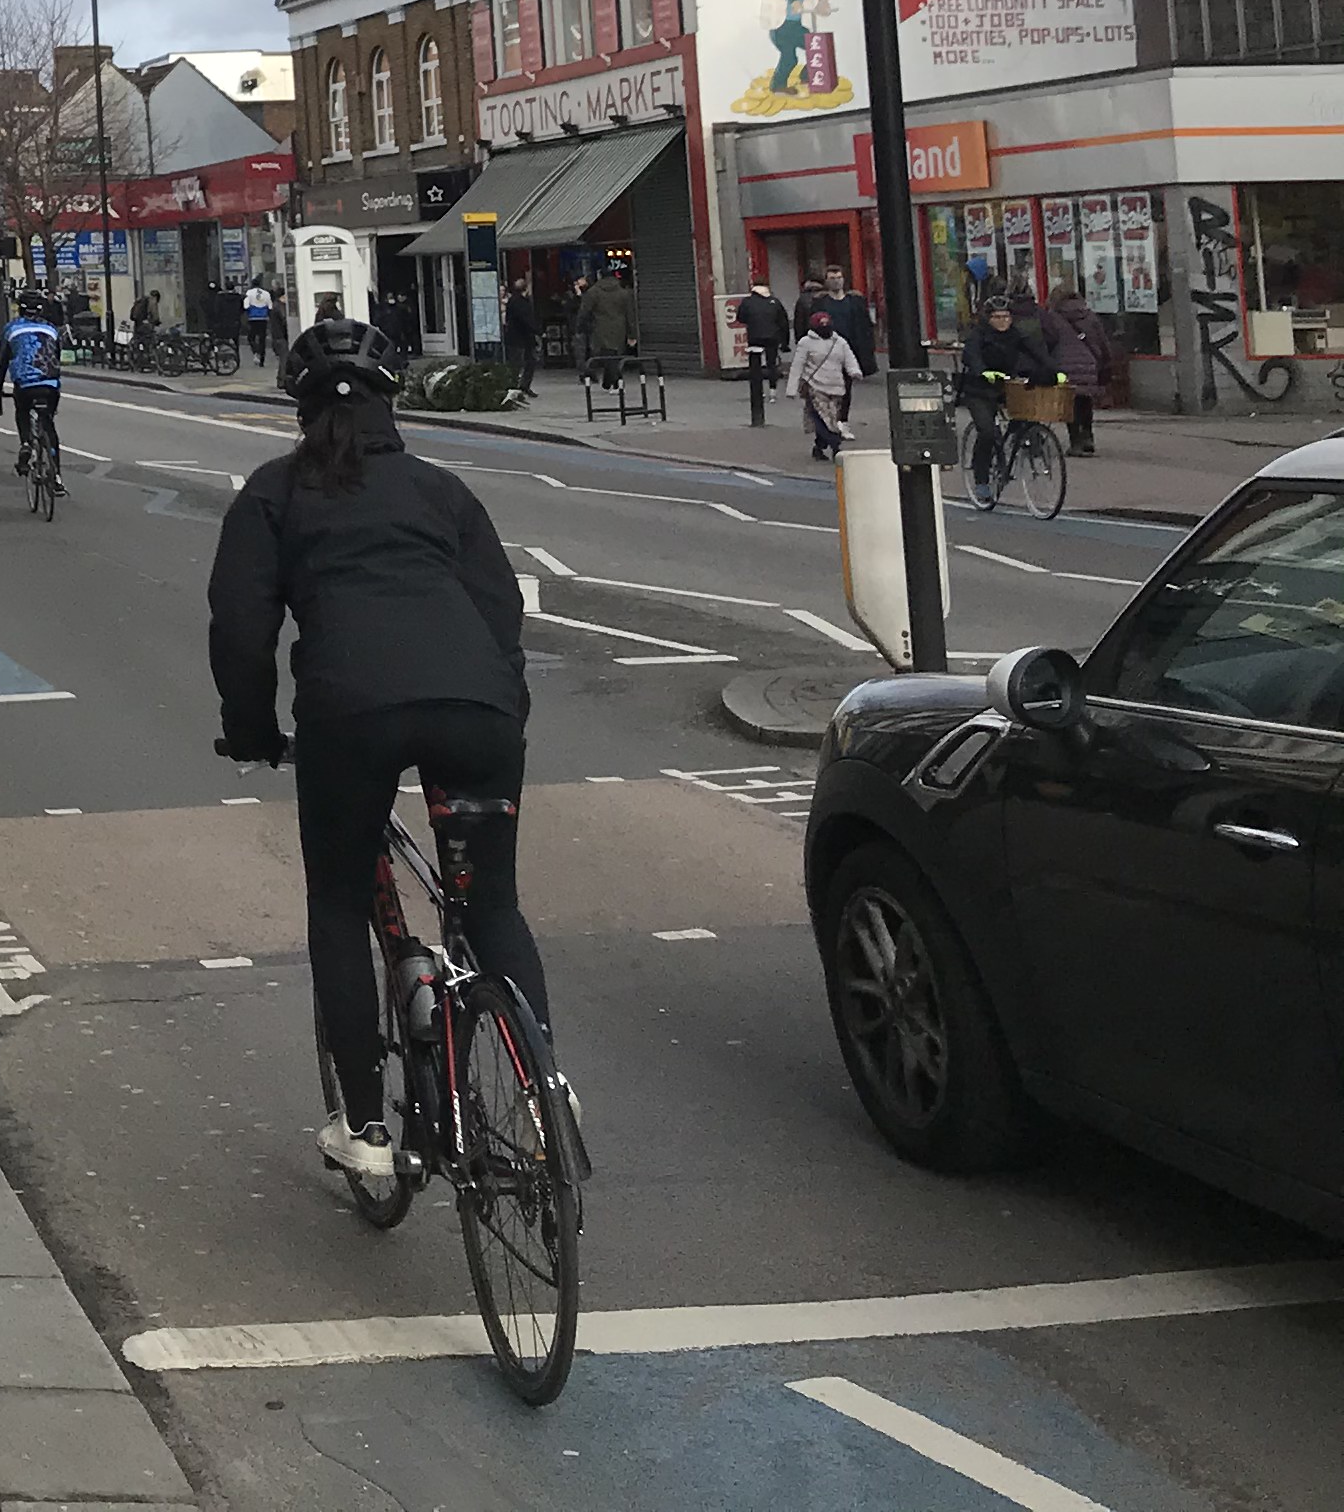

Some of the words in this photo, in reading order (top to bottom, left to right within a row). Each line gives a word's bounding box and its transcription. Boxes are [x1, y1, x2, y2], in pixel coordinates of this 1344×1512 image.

[929, 14, 959, 29] 100
[975, 12, 1025, 28] JOBS
[809, 34, 824, 51] £
[809, 52, 825, 69] £
[811, 70, 827, 87] £
[486, 90, 572, 138] TOOTING
[586, 66, 680, 123] MARKET
[362, 191, 414, 213] Superdrug
[314, 236, 336, 244] cash
